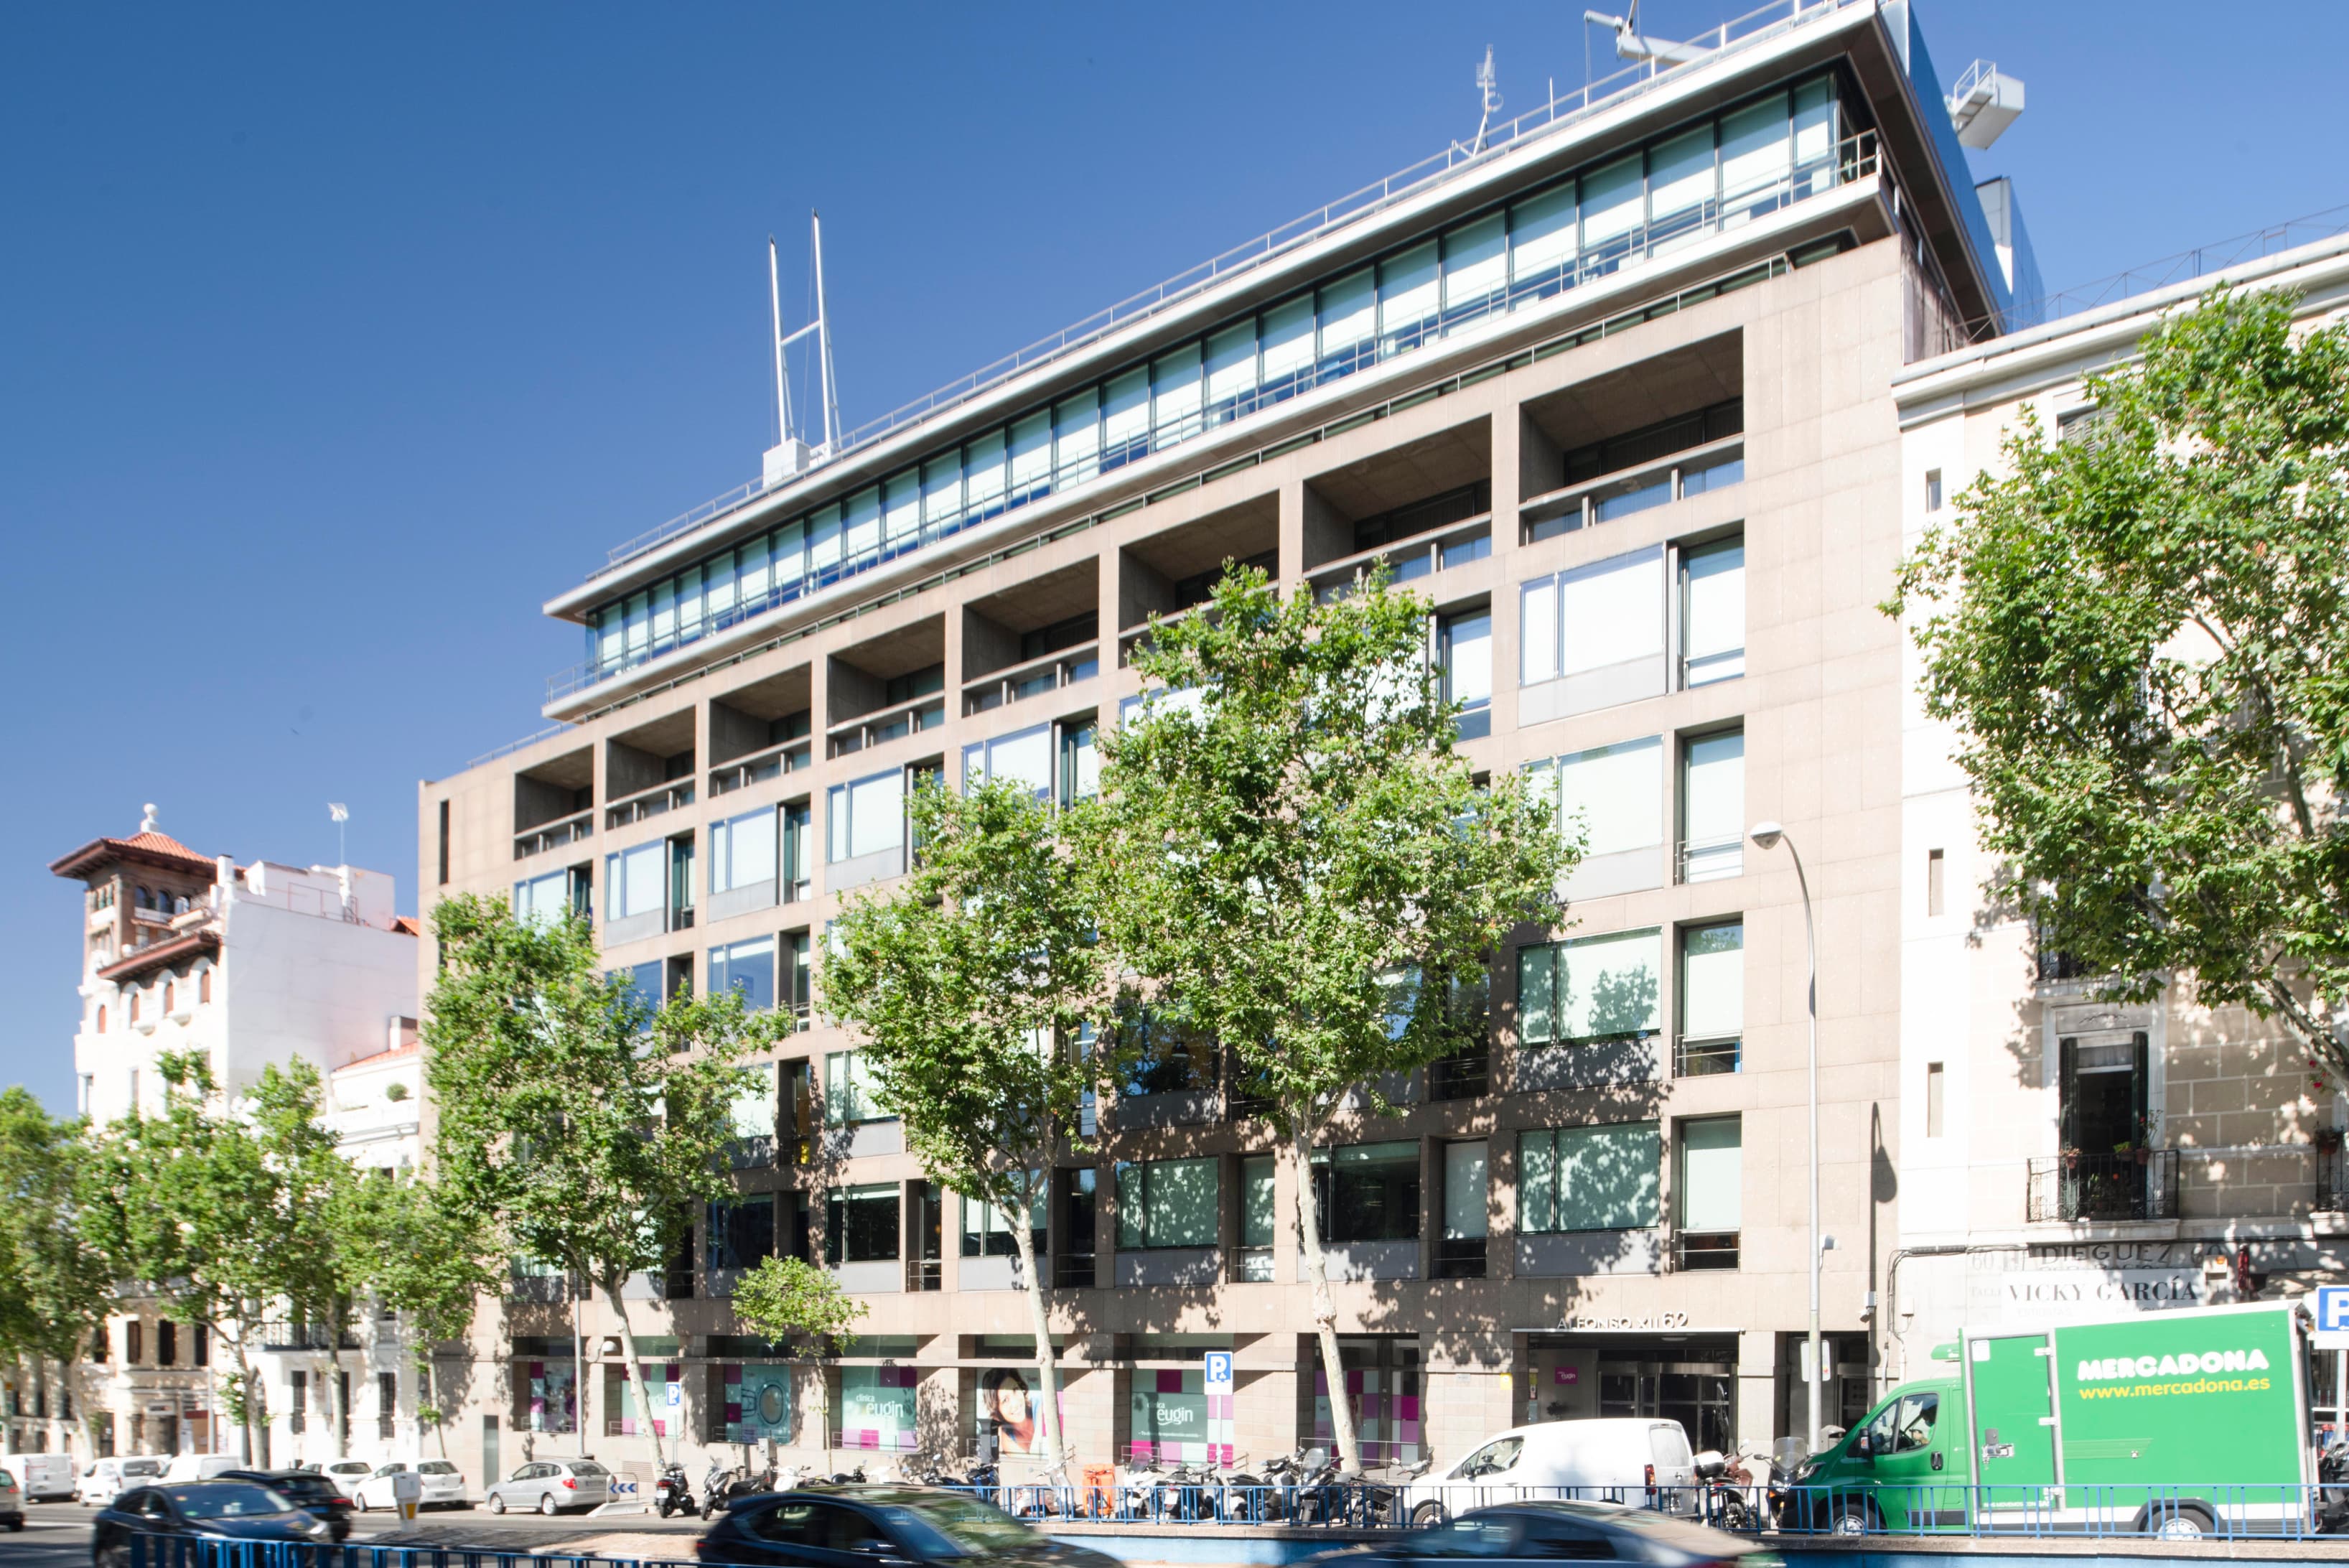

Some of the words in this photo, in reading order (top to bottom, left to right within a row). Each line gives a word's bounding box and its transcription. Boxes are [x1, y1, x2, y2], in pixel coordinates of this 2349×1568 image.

[2009, 1284, 2083, 1302] VICKY
[2096, 1275, 2199, 1302] GARCÍA
[1556, 1316, 1632, 1329] ALFONSO
[1662, 1311, 1689, 1328] 62
[1210, 1355, 1228, 1381] P
[2077, 1348, 2270, 1381] MERCADONA
[2079, 1378, 2271, 1399] www.mercadona.es
[866, 1401, 904, 1419] eugin
[1157, 1407, 1193, 1425] eugin
